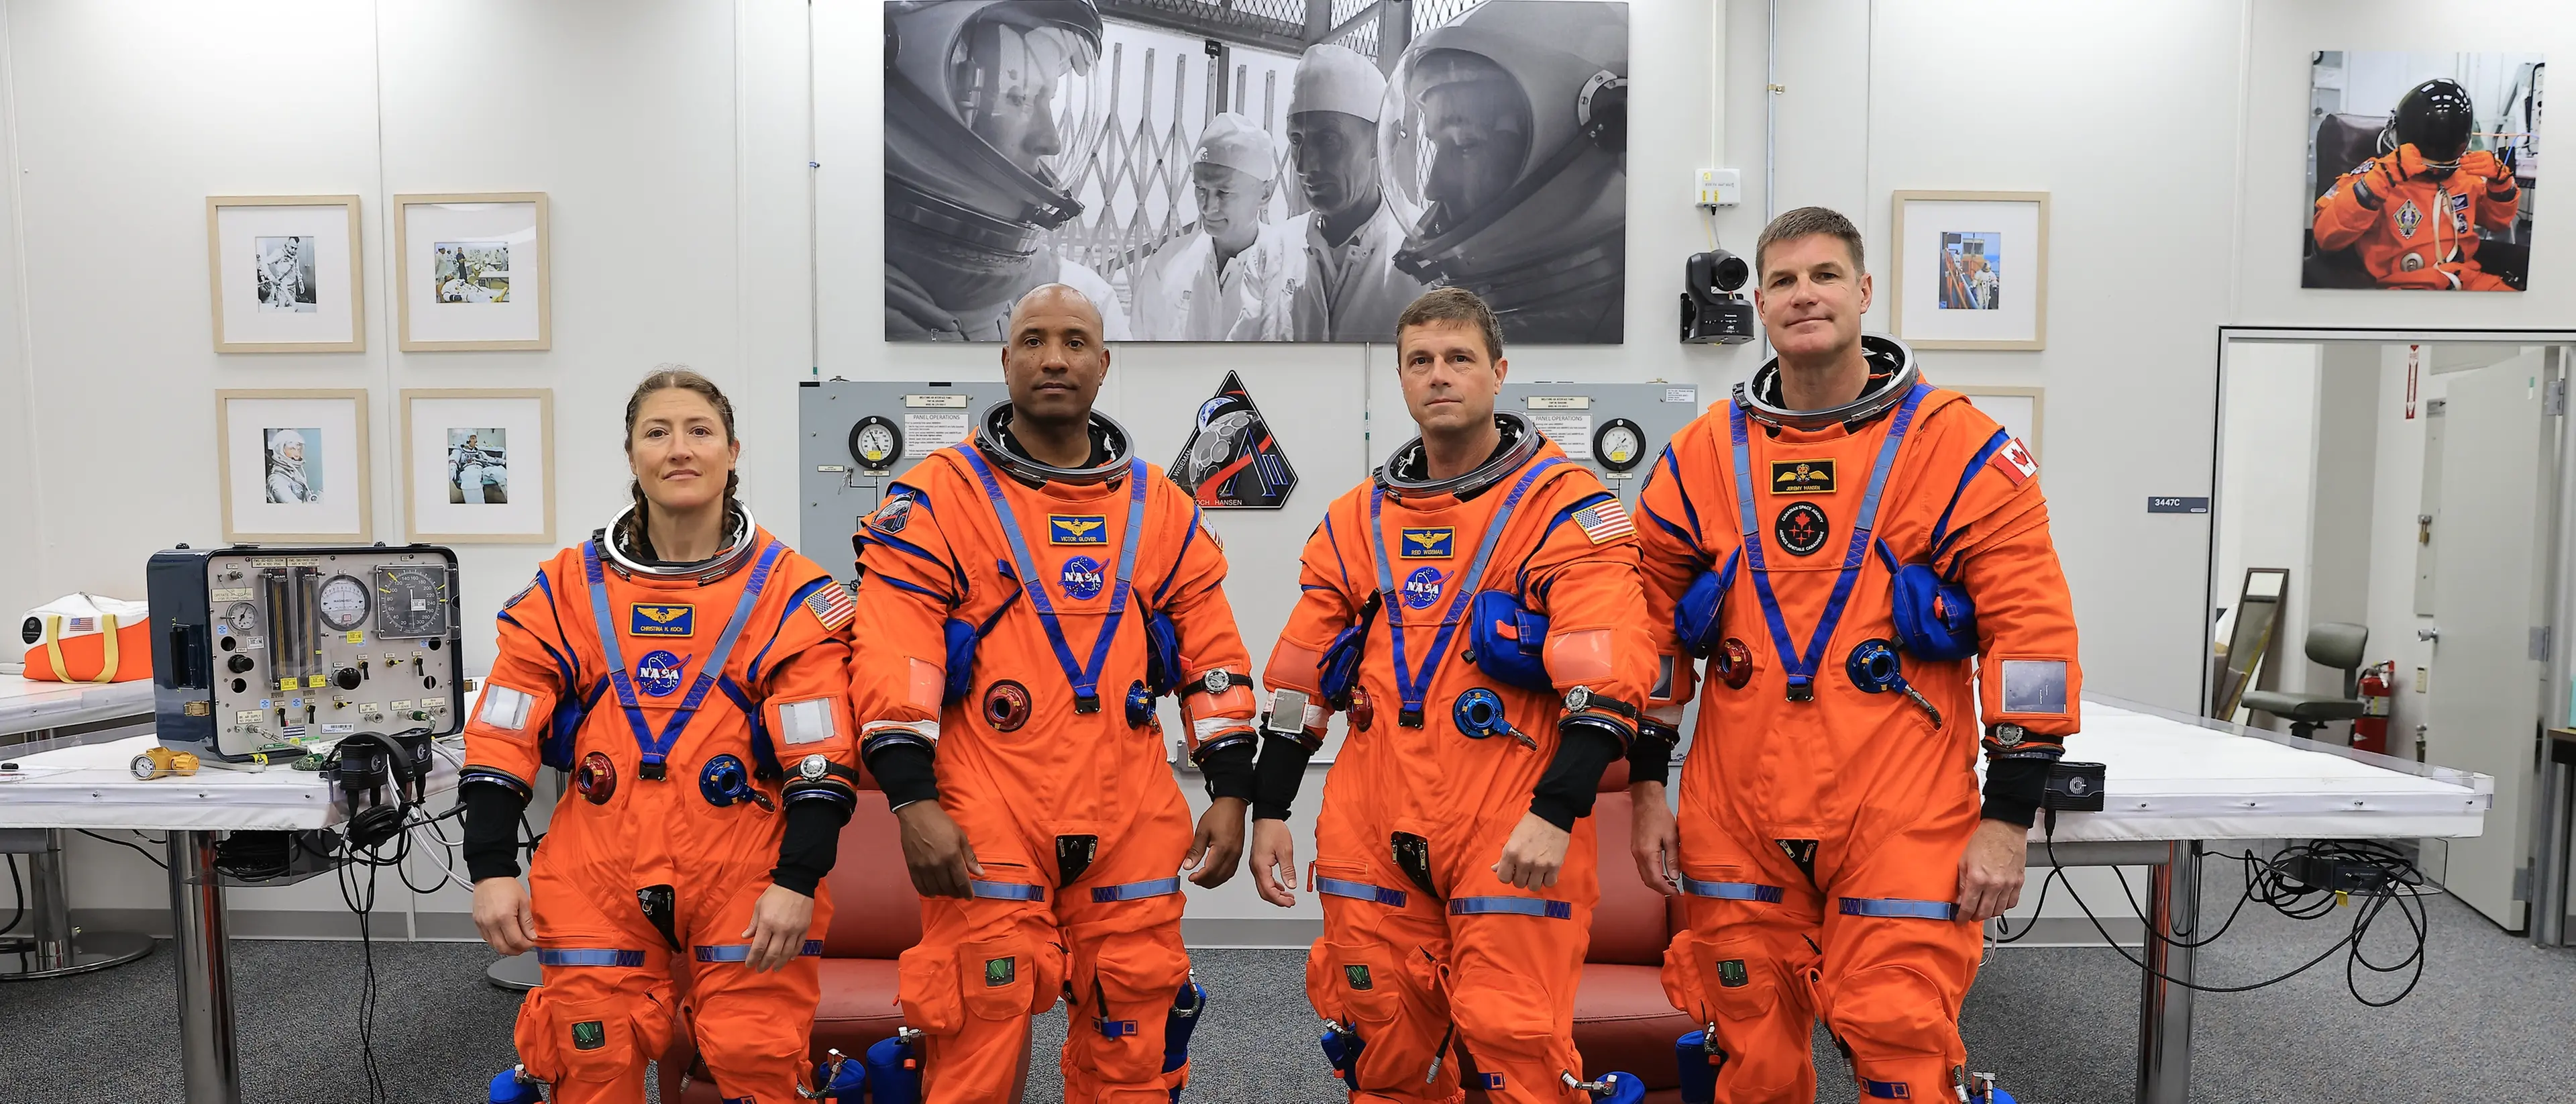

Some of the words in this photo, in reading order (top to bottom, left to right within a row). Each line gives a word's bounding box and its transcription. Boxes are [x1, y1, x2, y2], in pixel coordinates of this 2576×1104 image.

[1173, 448, 1193, 477] WISEMAN
[2155, 498, 2180, 506] 3447C
[1781, 506, 1799, 521] CANADIAN
[1811, 509, 1824, 523] AGENCY
[1779, 529, 1788, 545] AGENCE
[1787, 542, 1805, 552] SPATIALE
[1806, 531, 1825, 550] CANADIENNE
[1064, 572, 1102, 583] NASA
[1406, 581, 1439, 595] NASA
[640, 667, 679, 679] NASA
